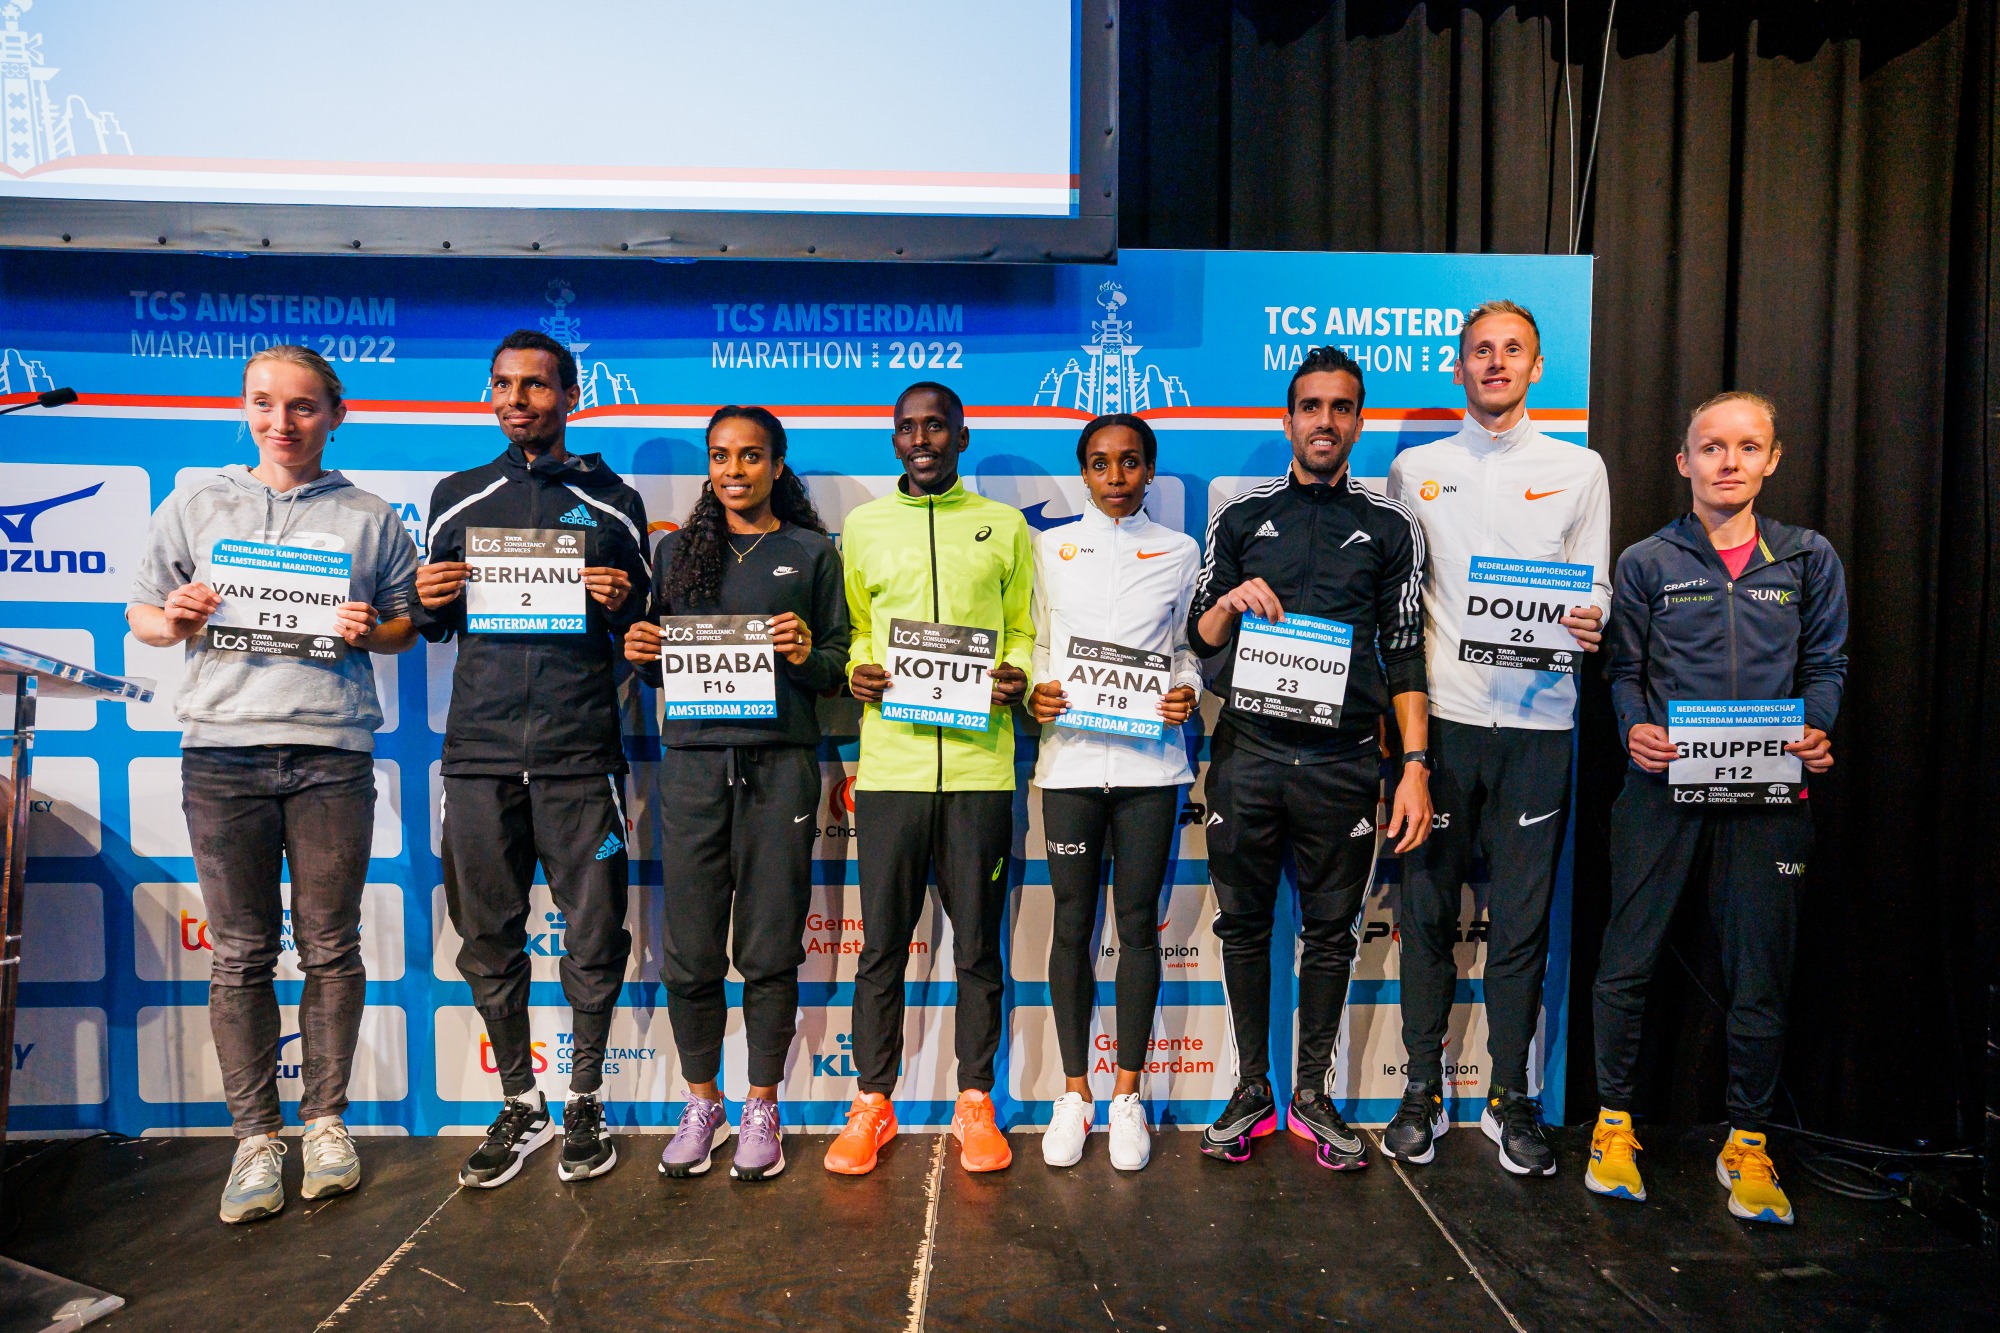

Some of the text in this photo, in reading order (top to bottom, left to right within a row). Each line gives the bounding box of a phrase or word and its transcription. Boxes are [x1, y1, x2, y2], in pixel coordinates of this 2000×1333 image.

[129, 290, 396, 326] TCS AMSTERDAM
[712, 303, 964, 333] TCS AMSTERDAM
[1265, 306, 1477, 337] TCS AMSTERD
[319, 335, 396, 363] 2022
[711, 341, 963, 369] MARATHON 2022
[559, 516, 599, 528] adidas
[471, 534, 501, 553] tcs
[221, 543, 344, 564] NEDERLANDS KAMPIOENSCHAP
[214, 554, 349, 576] TCS AMSTERDAM MARATHON 2022
[1477, 561, 1587, 577] NEDERLANDS KAMPIOENSCHAP
[469, 566, 582, 584] BERHANU
[1470, 572, 1591, 590] TCS AMSTERDAM MARATHON 2022
[1663, 580, 1699, 591] CRAFT
[212, 582, 346, 607] VAN ZOONEN
[521, 592, 532, 607] 2
[1467, 595, 1581, 624] DOUM
[258, 612, 298, 629] F13
[470, 618, 583, 630] AMSTERDAM 2022
[1292, 618, 1347, 634] KAMPIOENSCHAP
[213, 630, 248, 651] tcs
[251, 633, 273, 641] TATA
[665, 624, 694, 642] tcs
[893, 626, 921, 646] tcs
[922, 635, 961, 645] CONSULTANCY
[1243, 621, 1351, 646] TCS AMSTERDAM MARATHON 2022
[1509, 628, 1535, 643] 26
[251, 640, 299, 650] CONSULTANCY
[251, 646, 282, 654] SERVICES
[922, 641, 947, 649] SERVICES
[968, 645, 990, 655] TATA
[1072, 642, 1099, 658] tcs
[309, 650, 336, 659] TATA
[1239, 647, 1346, 676] CHOUKOUD
[1464, 644, 1494, 664] tcs
[1496, 654, 1540, 663] CONSULTANCY
[665, 652, 774, 674] DIBABA
[894, 656, 988, 684] KOTUT
[1144, 661, 1166, 669] TATA
[1495, 660, 1523, 668] SERVICES
[1548, 663, 1574, 673] TATA
[703, 680, 736, 693] F16
[1067, 664, 1163, 695] AYANA
[1276, 678, 1299, 694] 23
[932, 687, 943, 700] 3
[1096, 693, 1128, 710] F18
[1264, 696, 1282, 705] TATA
[668, 704, 774, 716] AMSTERDAM 2022
[1234, 692, 1262, 713] tcs
[1263, 703, 1303, 714] CONSULTANCY
[1676, 704, 1796, 713] NEDERLANDS KAMPIOENSCHAP
[883, 706, 986, 728] AMSTERDAM 2022
[1262, 708, 1288, 718] SERVICES
[1310, 715, 1333, 726] TATA
[1670, 715, 1802, 724] TCS AMSTERDAM MARATHON 2022
[1057, 712, 1160, 736] AMSTERDAM 2022
[1715, 766, 1753, 780] F12
[1674, 787, 1705, 803] tcs
[1764, 796, 1792, 804] TATA
[523, 933, 569, 957] KL
[1101, 945, 1115, 957] le
[480, 1033, 548, 1074] ts
[1383, 1064, 1397, 1075] le
